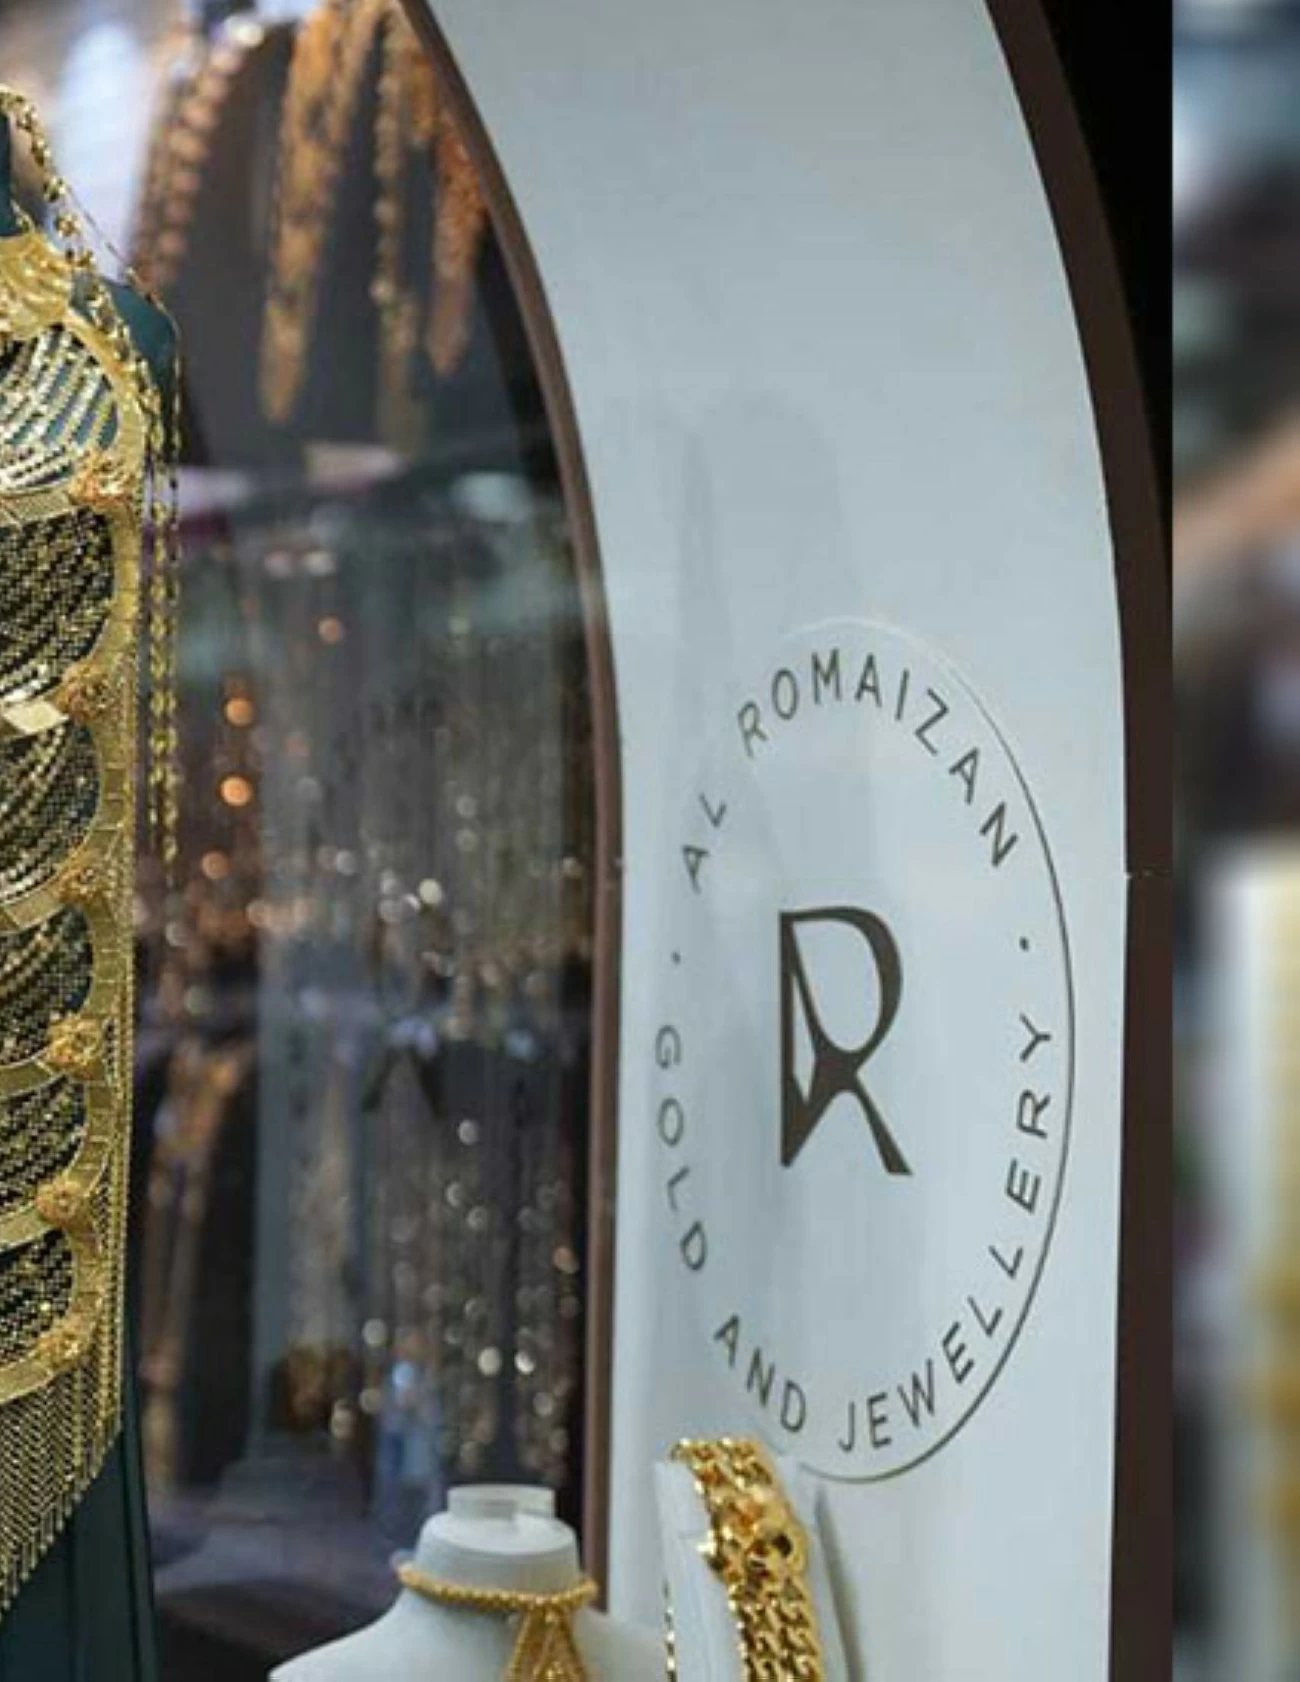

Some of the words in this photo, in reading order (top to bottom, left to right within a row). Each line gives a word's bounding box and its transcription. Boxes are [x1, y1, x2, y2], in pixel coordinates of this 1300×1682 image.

[681, 793, 727, 892] AL
[737, 649, 1018, 868] ROMAIZAN
[779, 906, 913, 1176] R
[654, 1025, 708, 1271] GOLD
[713, 1315, 806, 1432] AND
[838, 1014, 1052, 1453] JEWELLERY
